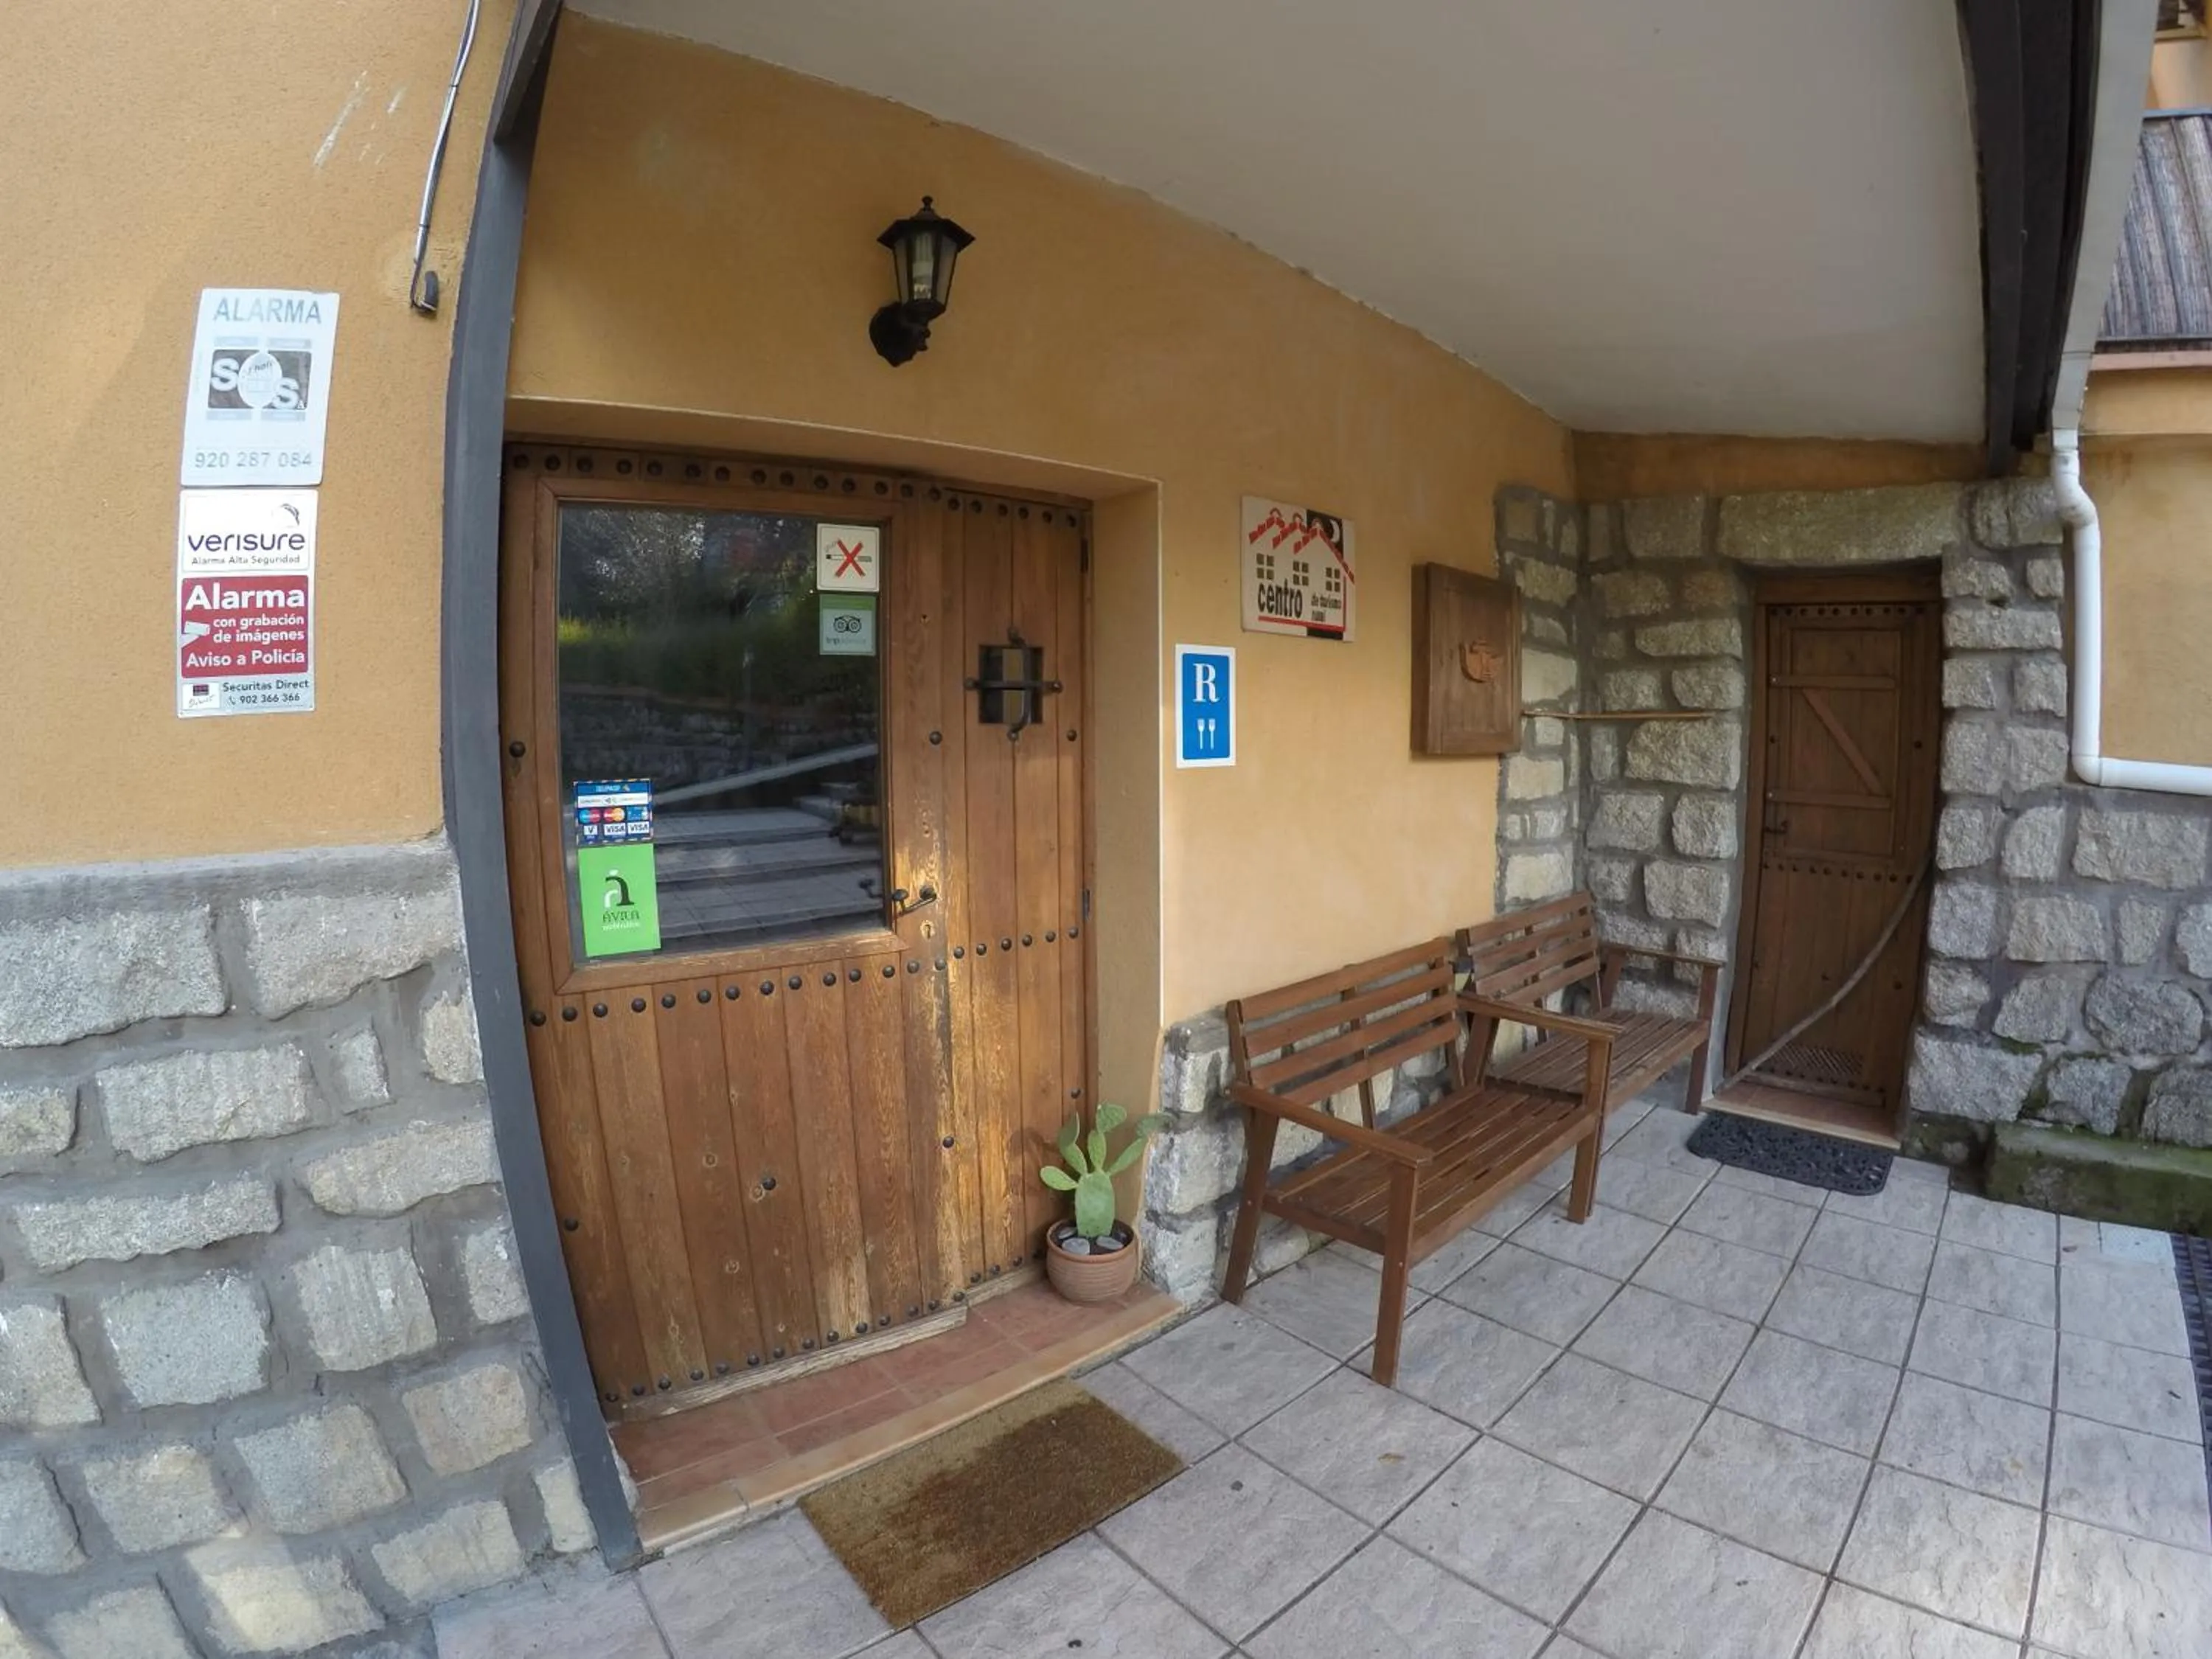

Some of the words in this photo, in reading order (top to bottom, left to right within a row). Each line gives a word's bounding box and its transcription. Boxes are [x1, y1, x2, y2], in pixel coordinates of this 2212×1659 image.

[213, 297, 321, 324] ALARMA
[195, 452, 229, 468] 920
[237, 451, 271, 467] 287
[187, 533, 305, 552] verisure
[192, 556, 225, 566] Alarma
[229, 555, 248, 565] Alta
[251, 555, 300, 566] Seguridad
[185, 582, 305, 611] Alarma
[1257, 578, 1303, 619] centro
[212, 618, 237, 628] con
[240, 613, 305, 630] grabación
[212, 631, 232, 643] de
[235, 629, 305, 645] imágenes
[186, 652, 232, 668] Aviso
[237, 654, 246, 666] a
[251, 648, 305, 665] Policía
[223, 681, 272, 692] Securitas
[275, 680, 309, 690] Direct
[1192, 663, 1220, 703] R
[240, 695, 257, 704] 902
[260, 694, 279, 703] 366
[281, 693, 300, 702] 366
[605, 824, 625, 833] VISA
[630, 824, 648, 832] VISA
